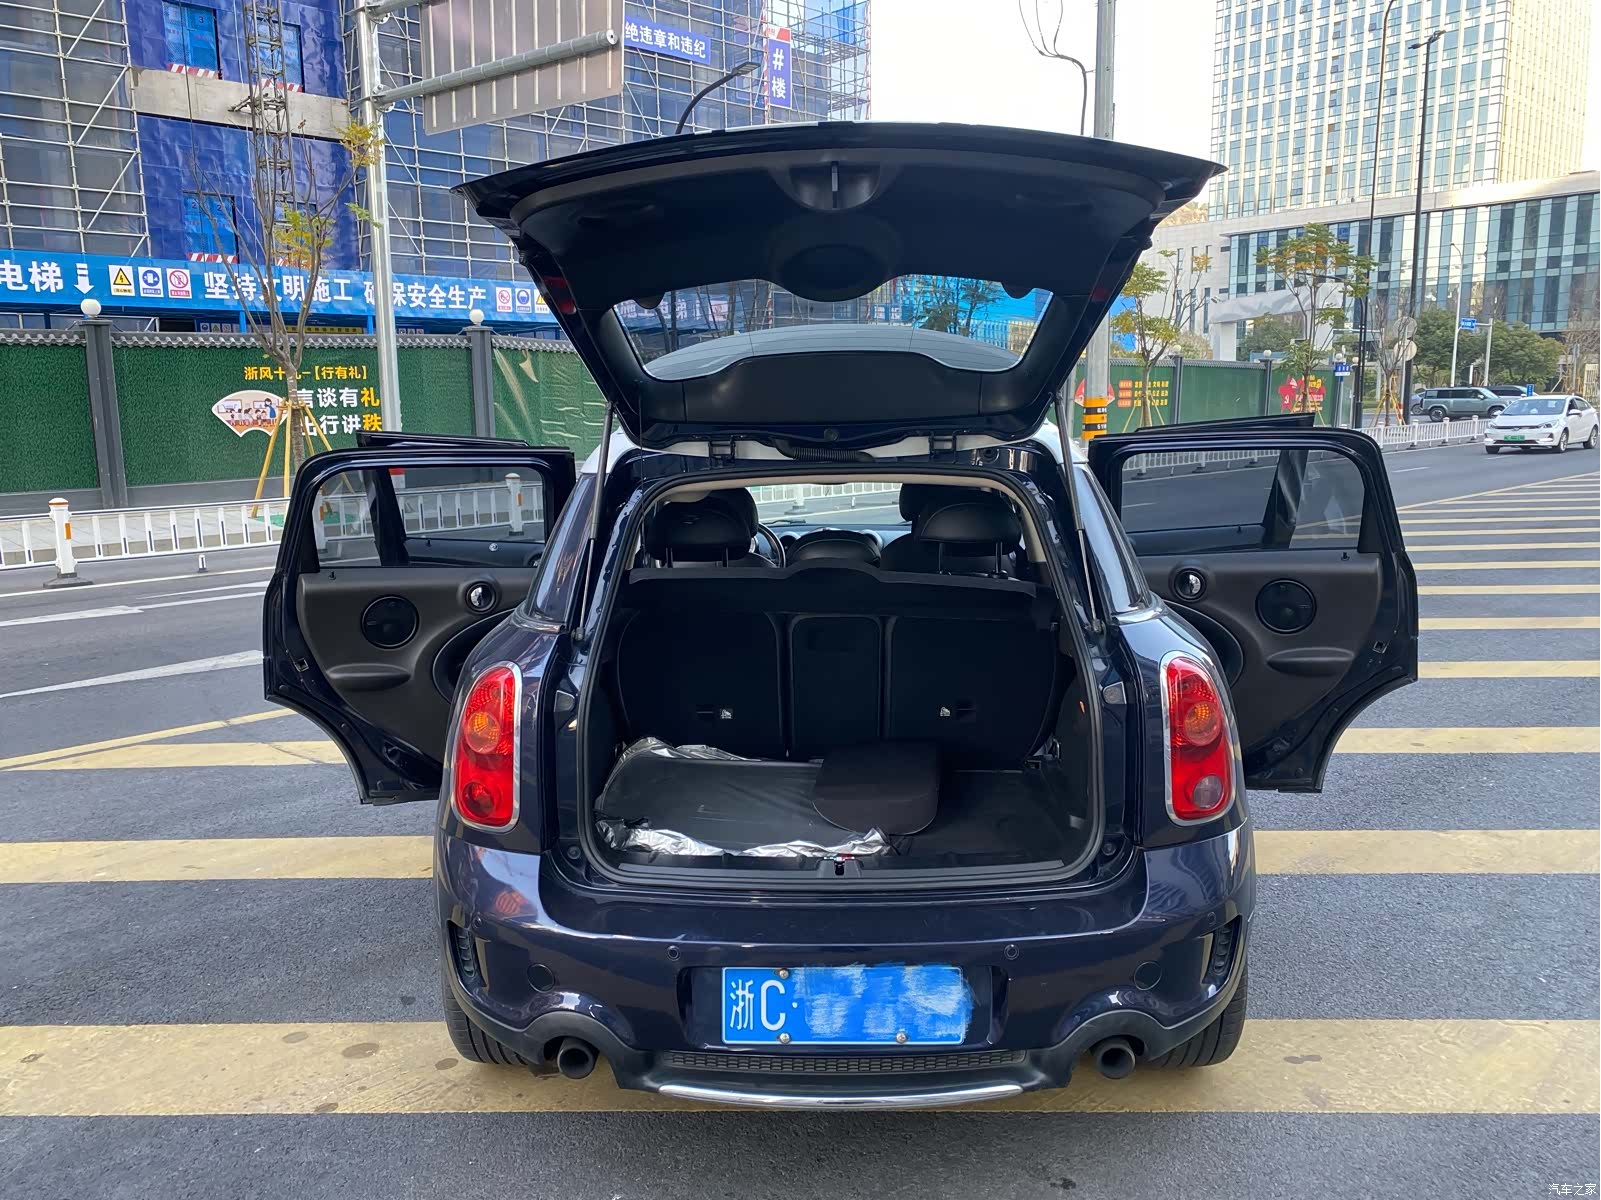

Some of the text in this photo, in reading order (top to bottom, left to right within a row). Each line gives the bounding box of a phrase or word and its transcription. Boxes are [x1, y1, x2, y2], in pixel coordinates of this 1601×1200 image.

[624, 21, 706, 59] 绝违章和违纪
[203, 271, 353, 303] 坚持文明施工
